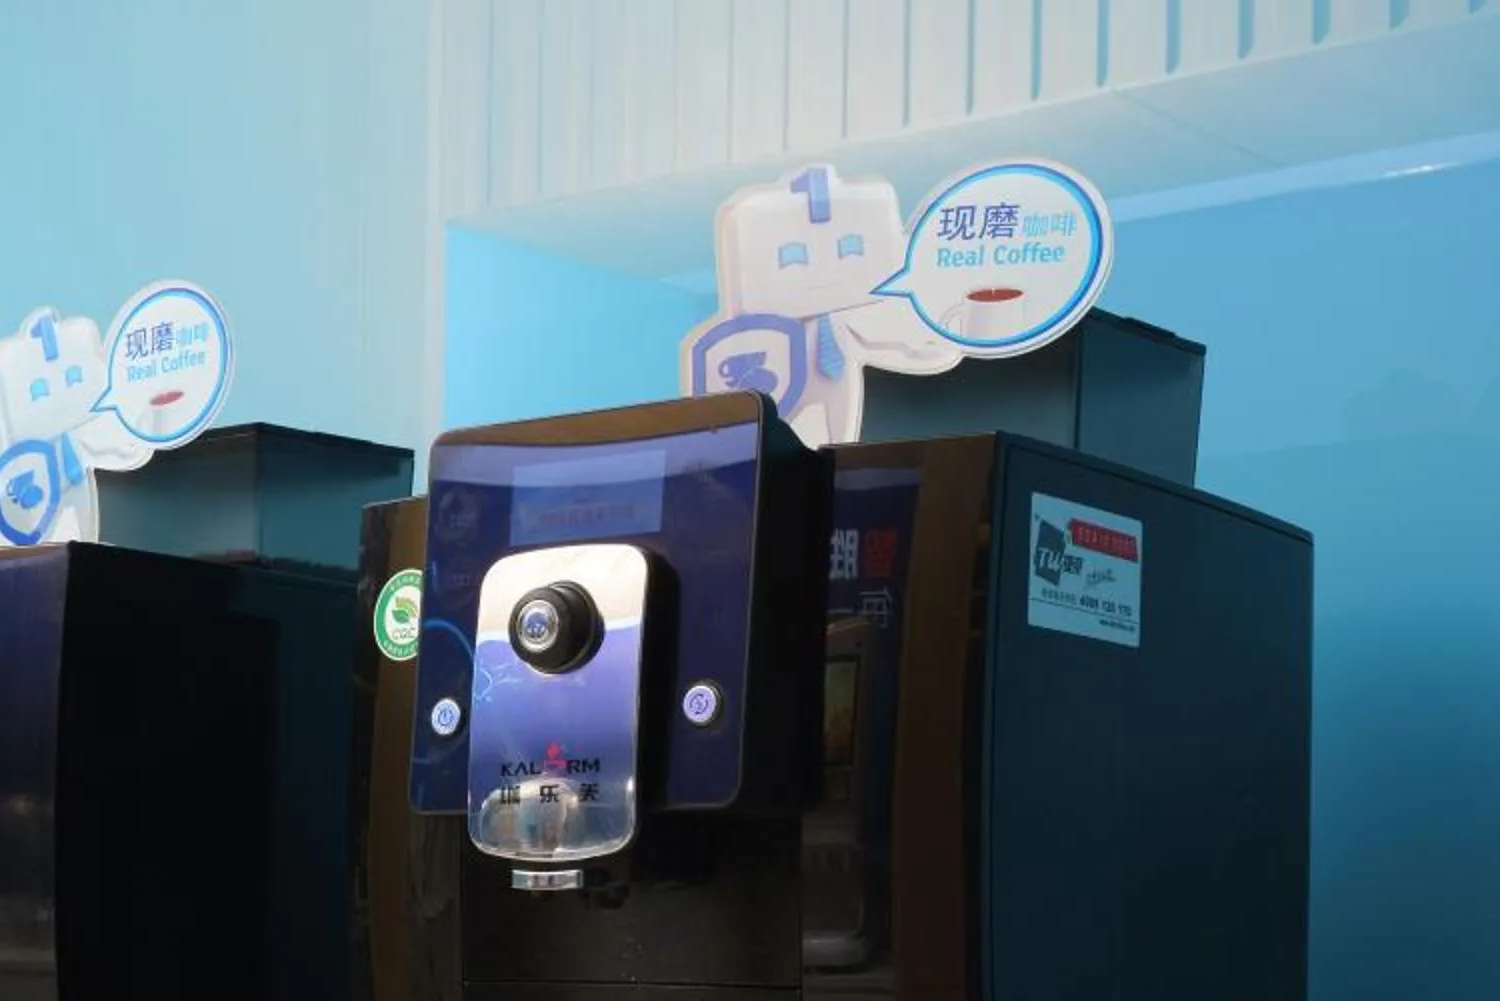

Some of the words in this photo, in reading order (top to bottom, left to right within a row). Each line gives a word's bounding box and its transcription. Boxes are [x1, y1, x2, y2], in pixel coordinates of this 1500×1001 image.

[937, 202, 1077, 241] 现磨咖啡
[936, 245, 984, 268] Real
[994, 241, 1065, 266] Coffee
